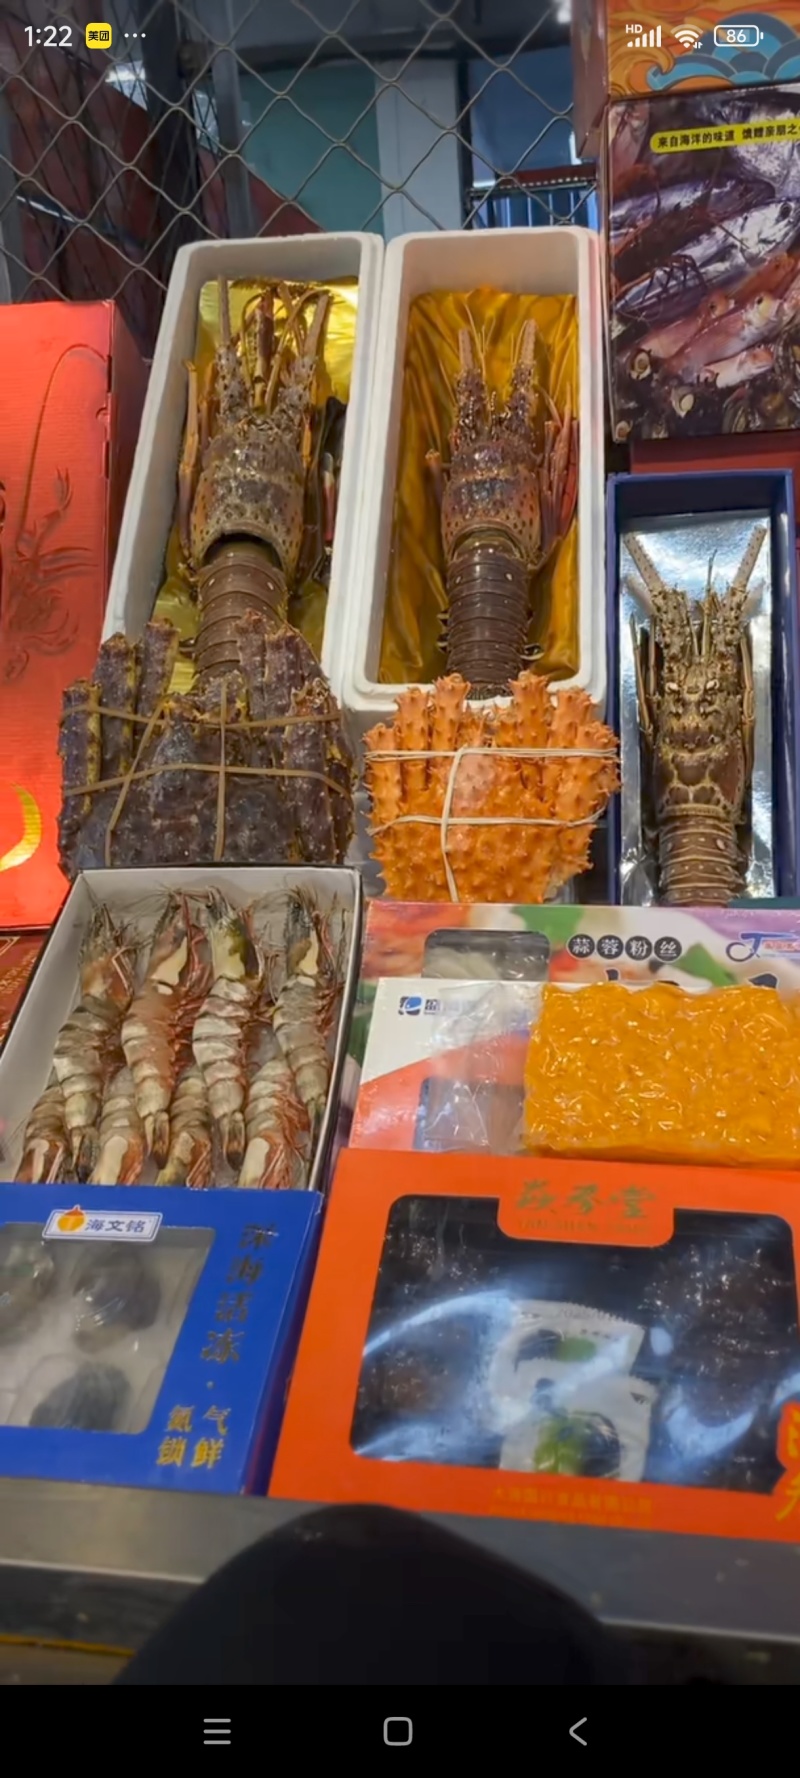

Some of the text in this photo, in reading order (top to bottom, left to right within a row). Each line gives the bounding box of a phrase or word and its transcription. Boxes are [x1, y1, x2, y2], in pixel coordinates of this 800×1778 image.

[657, 123, 800, 149] 来自海洋的味道 馈赠亲朋之
[569, 935, 680, 959] 蒜蓉粉丝
[85, 1219, 147, 1233] 海文铭
